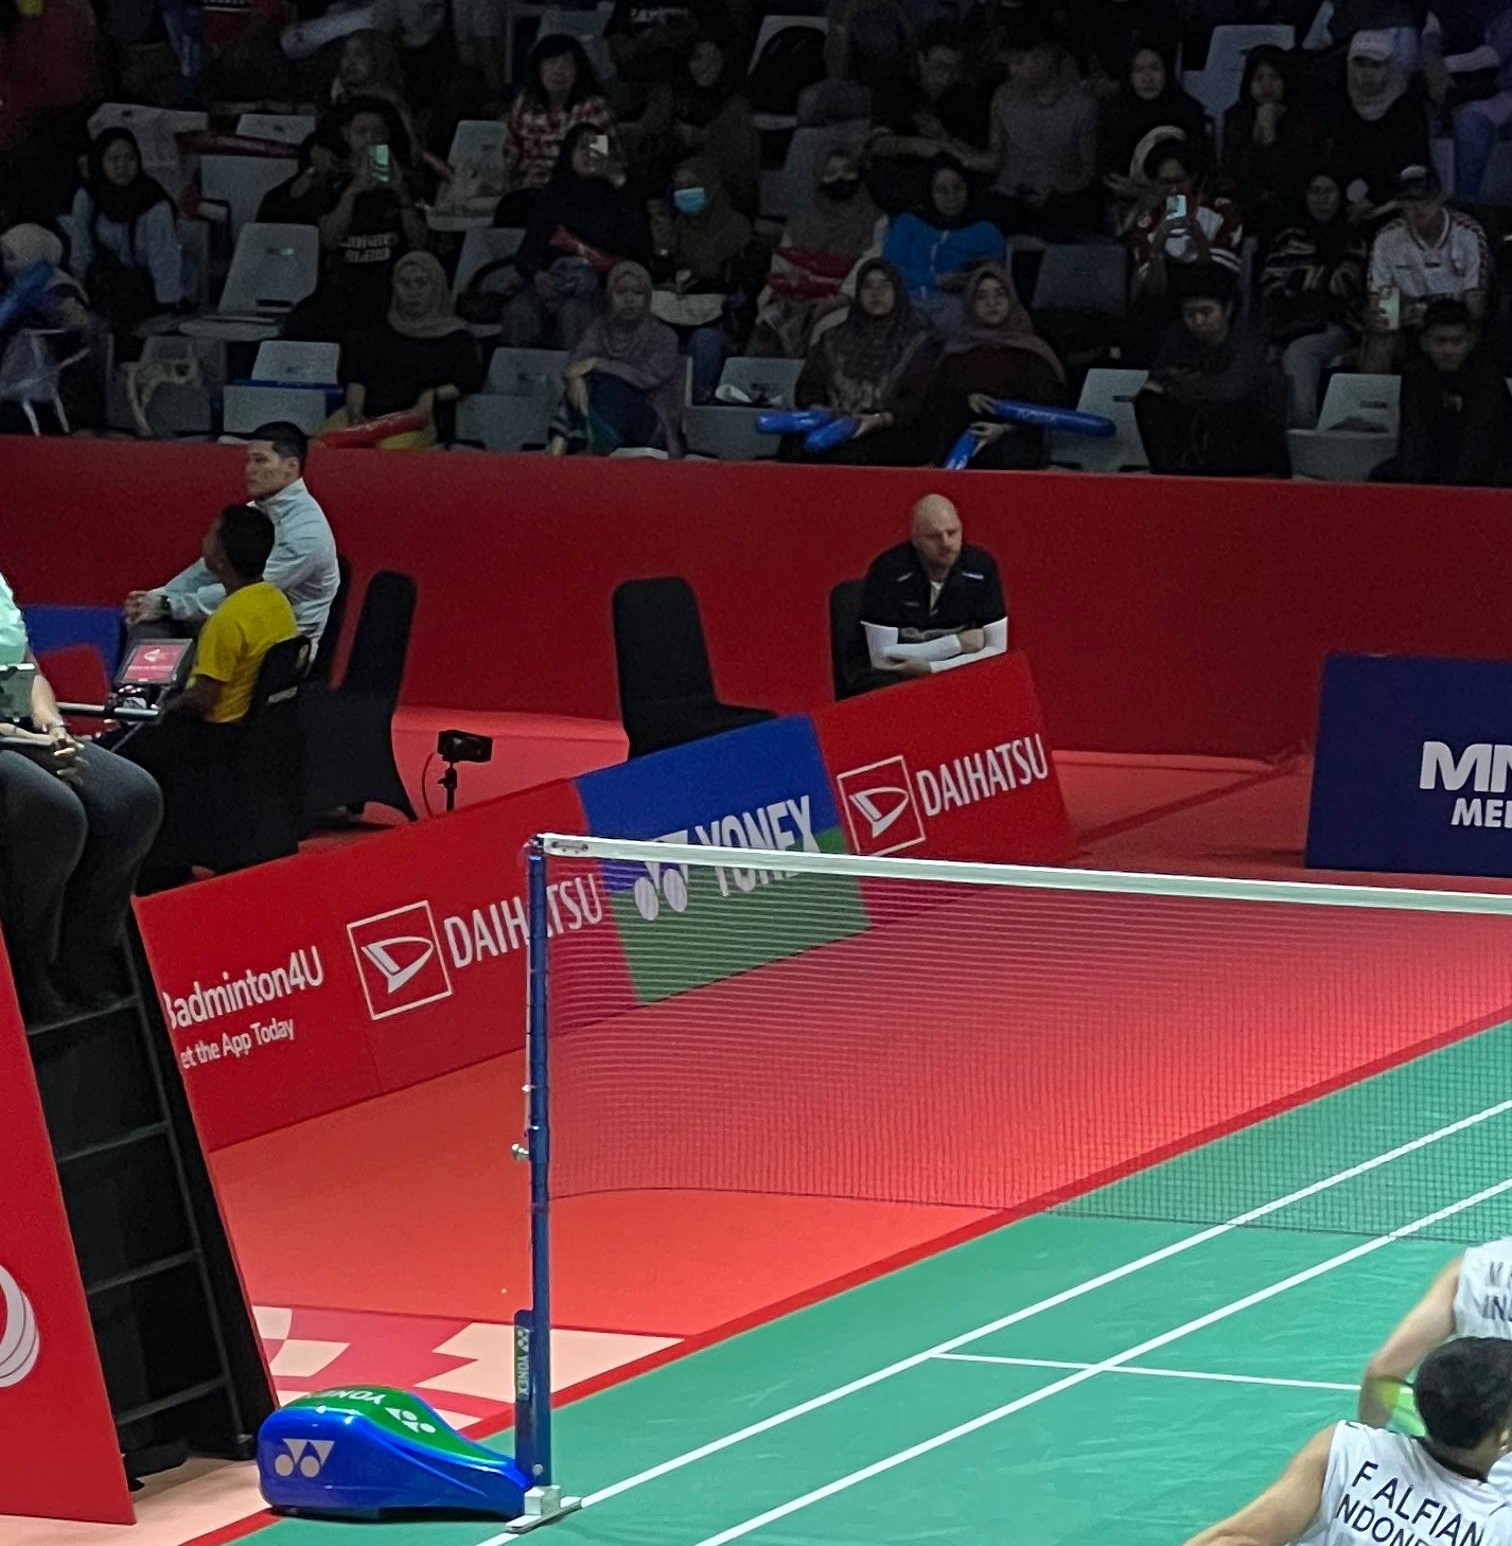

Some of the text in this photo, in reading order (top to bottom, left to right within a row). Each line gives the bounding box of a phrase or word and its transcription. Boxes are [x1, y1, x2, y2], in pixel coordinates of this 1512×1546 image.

[917, 733, 1049, 817] DAIHATSU
[695, 795, 820, 898] YONEX
[443, 873, 603, 969] DAIHTSU
[195, 1040, 221, 1064] the
[222, 1033, 252, 1058] App
[250, 1018, 295, 1046] Today
[1352, 1460, 1379, 1487] F
